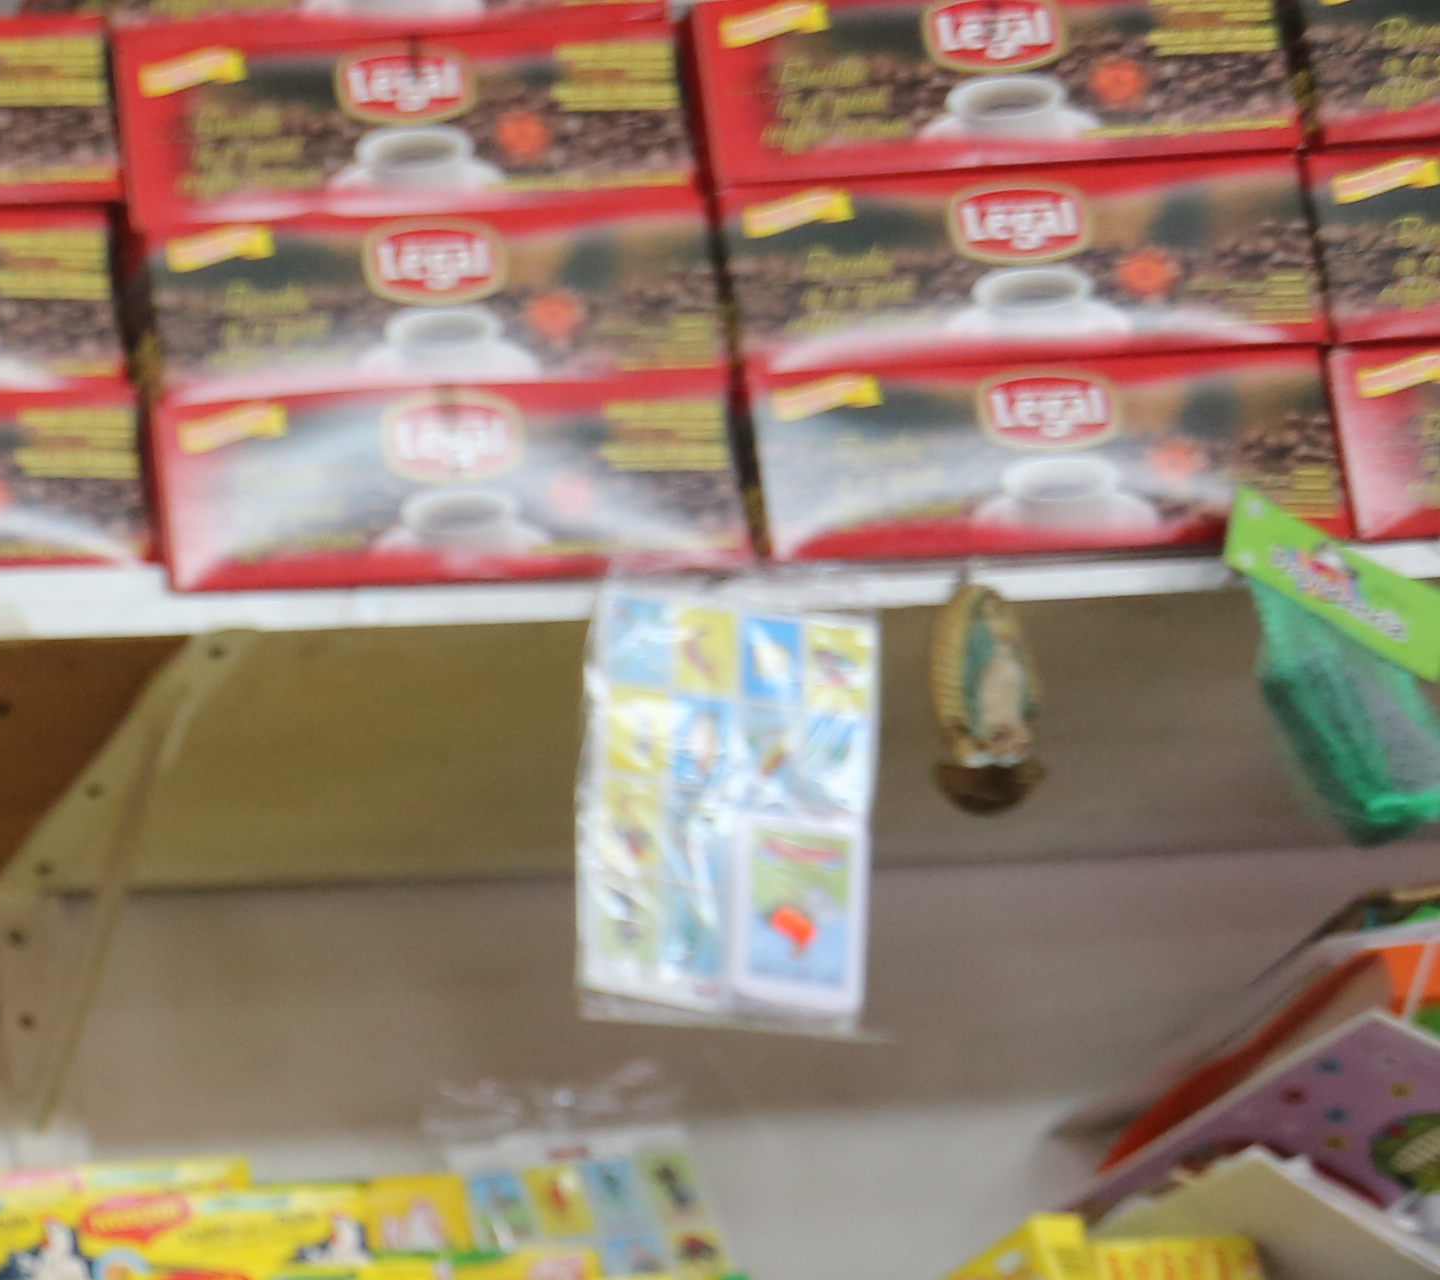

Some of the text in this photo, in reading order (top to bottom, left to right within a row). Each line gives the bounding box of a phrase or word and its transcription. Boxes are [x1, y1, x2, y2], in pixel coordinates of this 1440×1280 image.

[935, 7, 1048, 60] Legal
[349, 64, 460, 111] Legal
[961, 201, 1076, 249] Legal
[378, 240, 491, 291] Legal
[992, 389, 1106, 438] Legal
